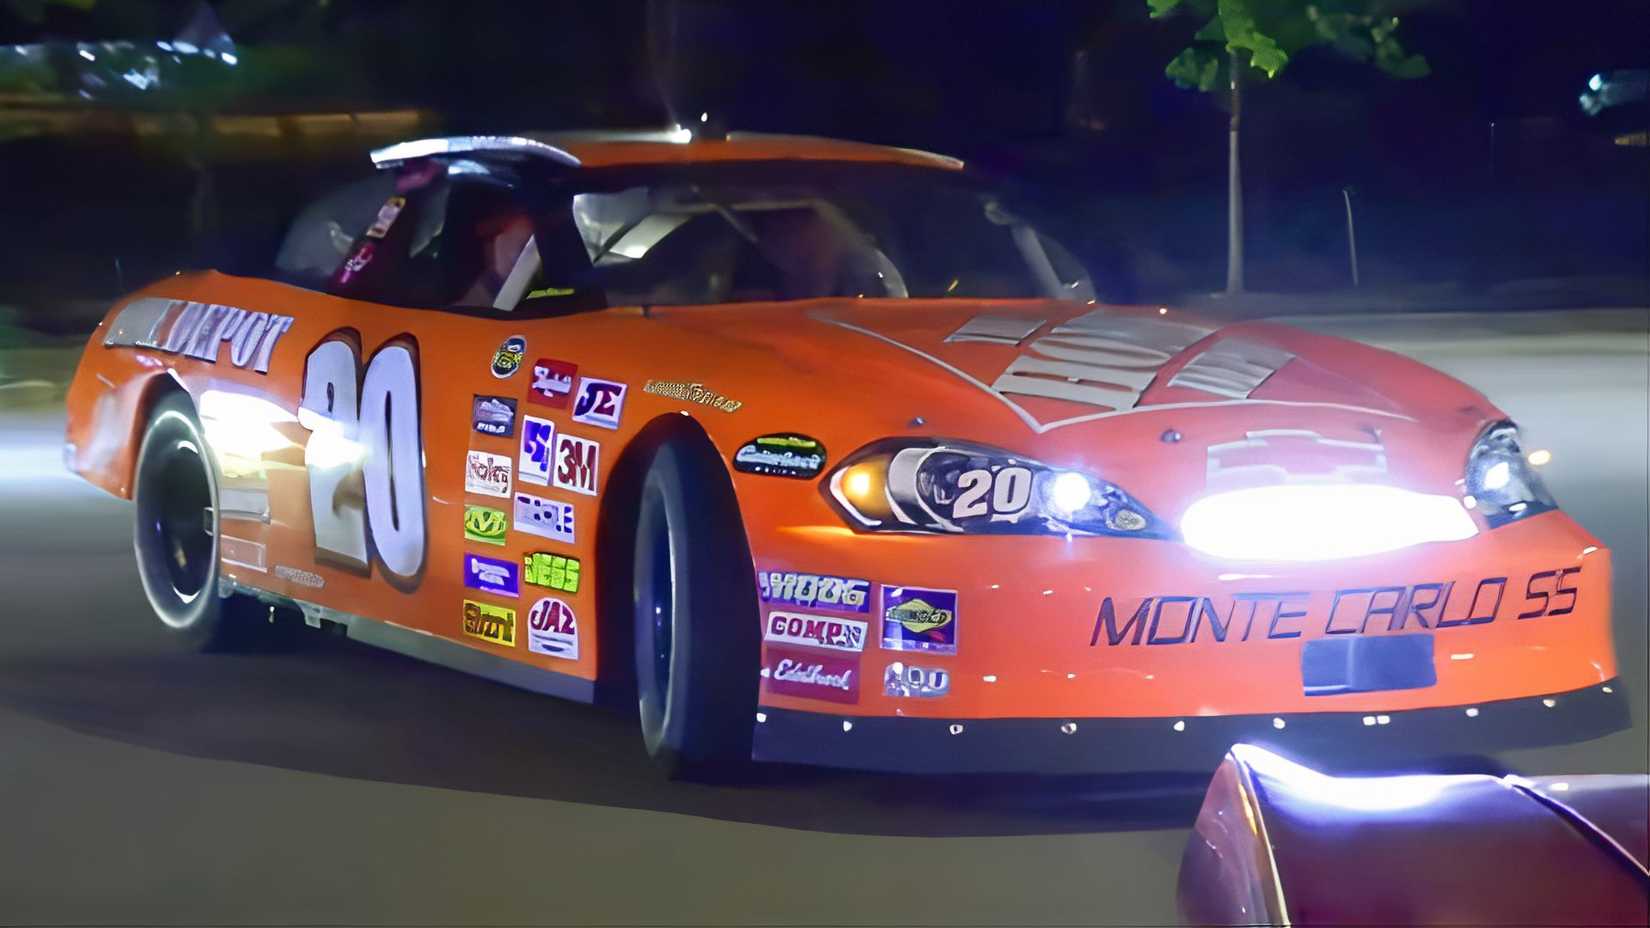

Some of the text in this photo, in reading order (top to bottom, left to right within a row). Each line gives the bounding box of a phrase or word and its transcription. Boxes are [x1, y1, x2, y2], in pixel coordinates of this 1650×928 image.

[299, 331, 427, 585] 20
[557, 439, 598, 492] 3M
[952, 466, 1033, 519] 20
[1090, 566, 1583, 646] MONTE CARLO SS
